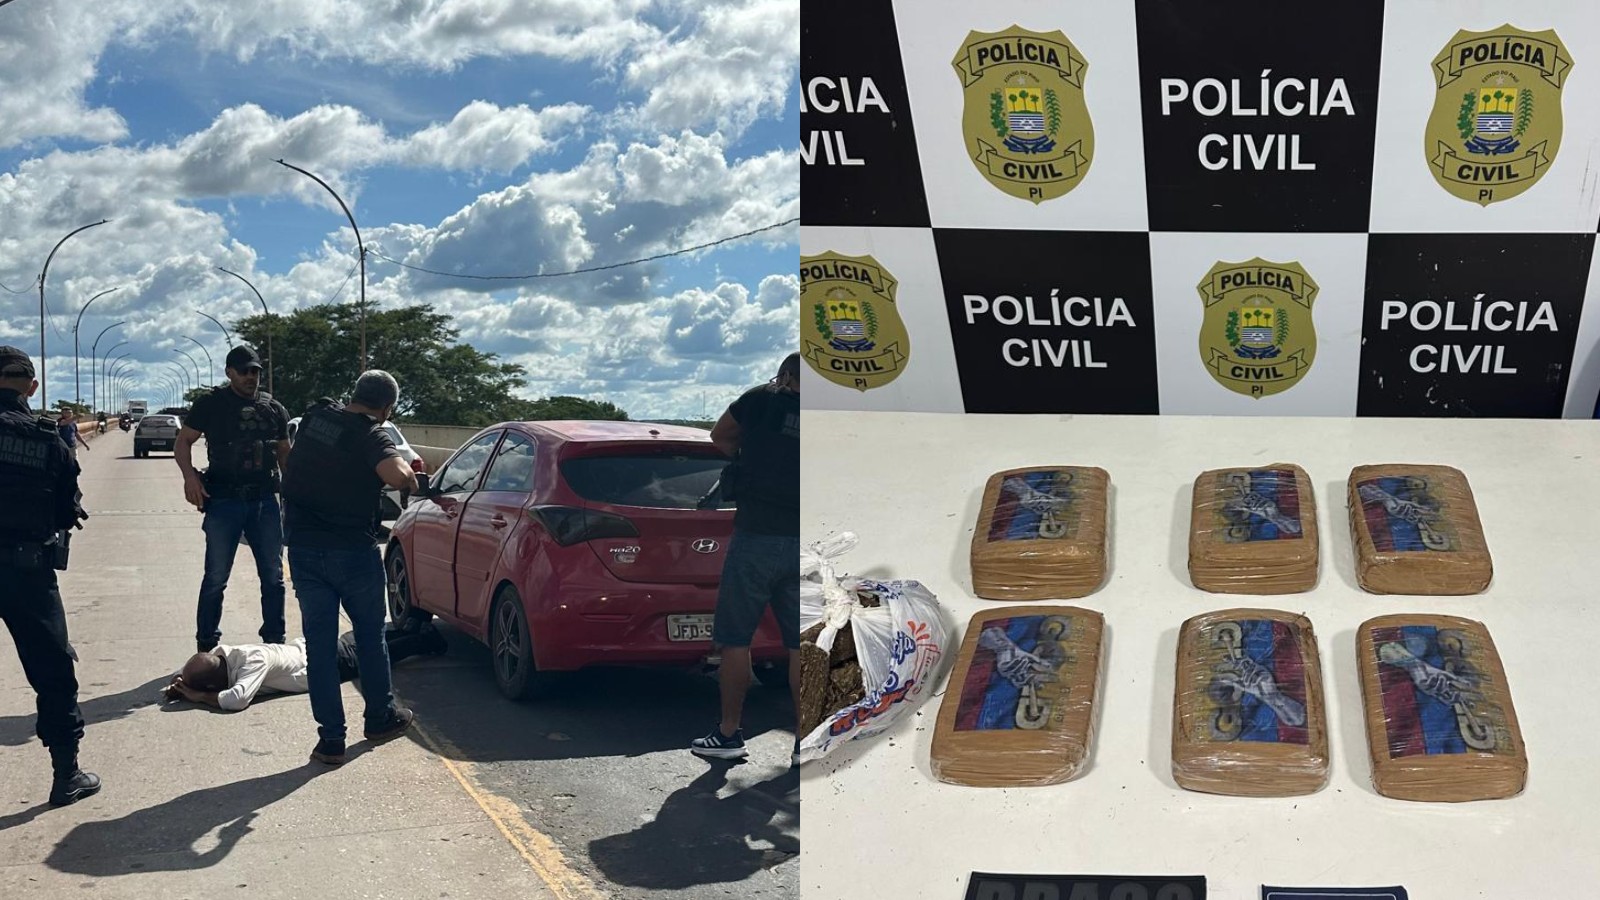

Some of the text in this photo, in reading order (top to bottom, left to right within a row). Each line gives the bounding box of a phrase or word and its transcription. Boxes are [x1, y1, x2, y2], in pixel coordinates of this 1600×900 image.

[977, 39, 1061, 68] POLÍCIA
[1459, 38, 1545, 67] POLÍCIA
[1161, 69, 1355, 116] POLÍCIA
[1198, 133, 1316, 171] CIVIL
[1003, 162, 1062, 180] CIVIL
[1457, 164, 1519, 182] CIVIL
[1029, 187, 1043, 199] PI
[1478, 189, 1493, 201] PI
[800, 261, 874, 284] POLÍCIA
[1220, 268, 1294, 292] POLÍCIA
[962, 288, 1136, 327] POLÍCIA
[1380, 293, 1558, 332] POLÍCIA
[1002, 337, 1108, 368] CIVIL
[1409, 343, 1518, 374] CIVIL
[830, 358, 884, 373] CIVIL
[1230, 365, 1284, 380] CIVIL
[855, 378, 868, 388] PI
[1251, 384, 1264, 395] PI
[0, 435, 47, 459] RACO
